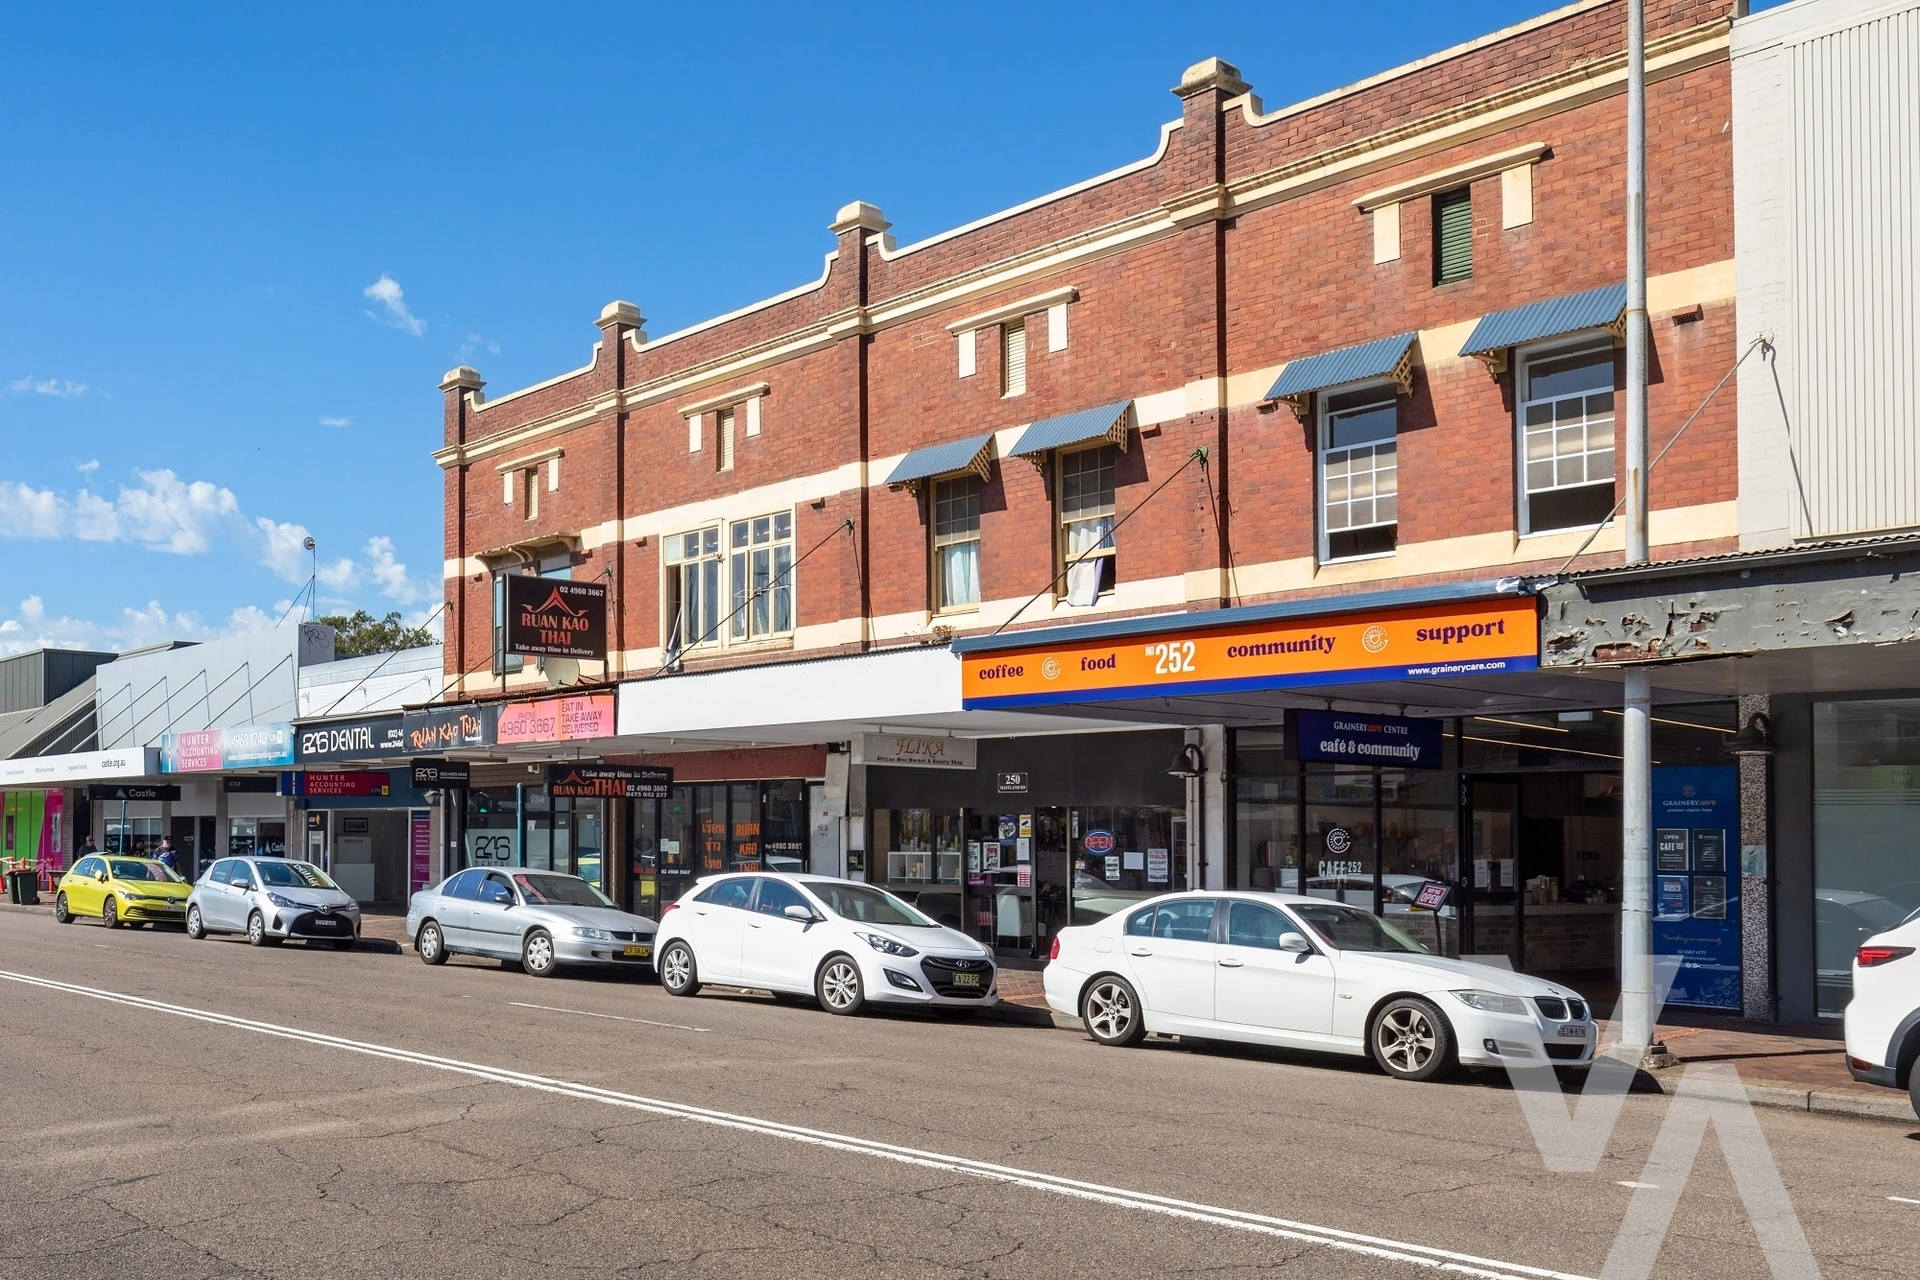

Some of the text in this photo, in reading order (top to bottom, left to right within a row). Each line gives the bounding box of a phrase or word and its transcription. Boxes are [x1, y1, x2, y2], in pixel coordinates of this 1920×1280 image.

[570, 587, 586, 595] 4960
[588, 588, 604, 596] 3667
[522, 613, 589, 631] RUAN KAO
[539, 630, 571, 645] THAI
[1416, 618, 1505, 644] support
[570, 648, 594, 656] Delivery
[1228, 634, 1336, 658] community
[1081, 654, 1116, 671] food
[1156, 640, 1196, 674] 252
[979, 664, 1024, 680] coffee
[1408, 661, 1506, 676] www.grainerycare.com
[562, 701, 583, 712] EAT IN
[518, 710, 537, 720] PHONE
[562, 710, 602, 723] TAKE AWAY
[500, 717, 556, 736] 4960 3667
[562, 722, 598, 734] DELIVERED
[1384, 725, 1408, 734] CENTRE
[182, 734, 210, 745] HUNTER
[231, 734, 248, 747] 4968
[250, 732, 266, 745] 1740
[303, 727, 374, 754] 246 DENTAL
[410, 726, 436, 748] RUAN
[439, 722, 458, 740] KAO
[182, 746, 218, 757] ACCOUNTING
[896, 738, 945, 758] FLIKA
[1320, 738, 1420, 761] café & community
[182, 758, 207, 768] SERVICES
[415, 768, 437, 778] 246
[581, 770, 597, 778] Take
[642, 772, 668, 780] Delivery
[1006, 775, 1021, 785] 250
[129, 789, 156, 798] Castle
[553, 779, 626, 796] RUAN KAO THAI
[736, 823, 760, 836] RUAN
[475, 836, 510, 860] 246
[740, 842, 757, 856] KAO
[1085, 836, 1113, 849] OPEN
[1660, 842, 1675, 851] CAFE
[1318, 860, 1362, 878] CAFE 252
[1420, 892, 1440, 905] OPEN
